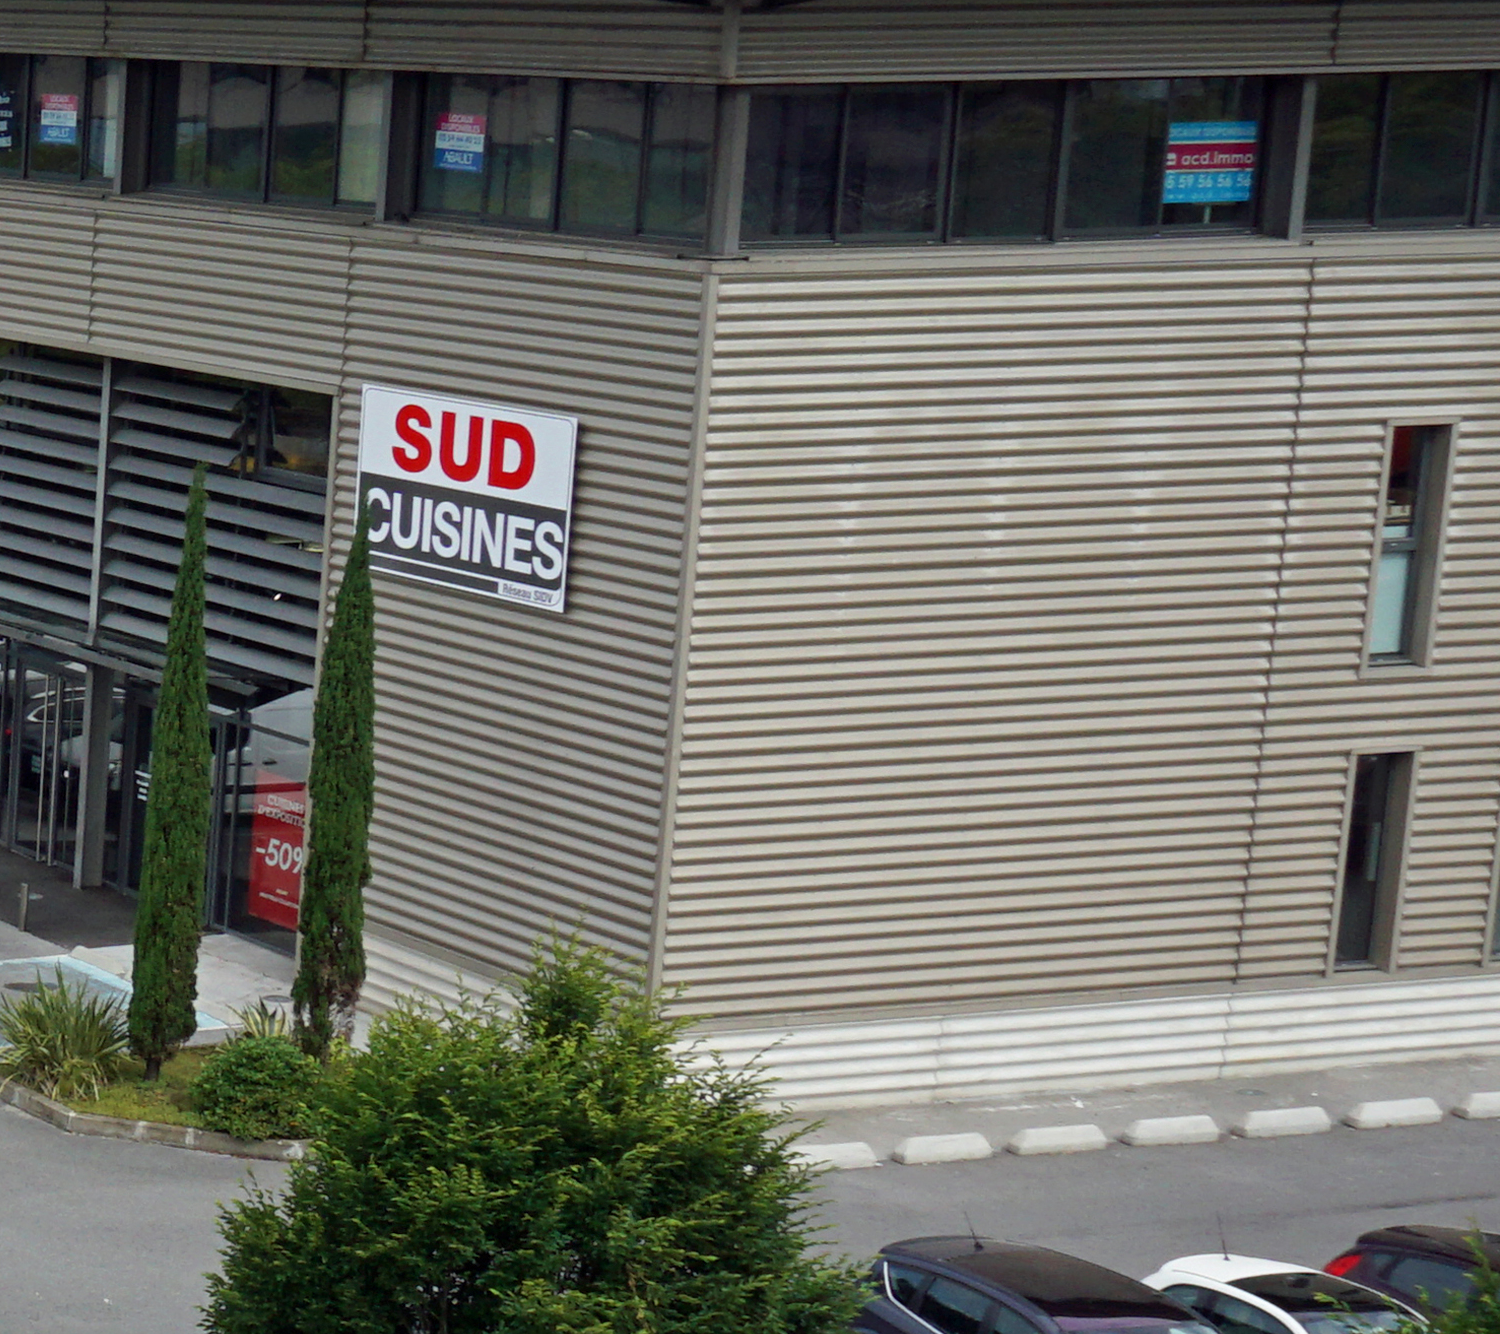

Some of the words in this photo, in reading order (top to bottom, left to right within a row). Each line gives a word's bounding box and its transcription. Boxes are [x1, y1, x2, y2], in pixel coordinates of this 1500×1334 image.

[1181, 151, 1253, 165] acd.immo
[391, 404, 536, 490] SUD
[366, 487, 565, 580] CUISINES
